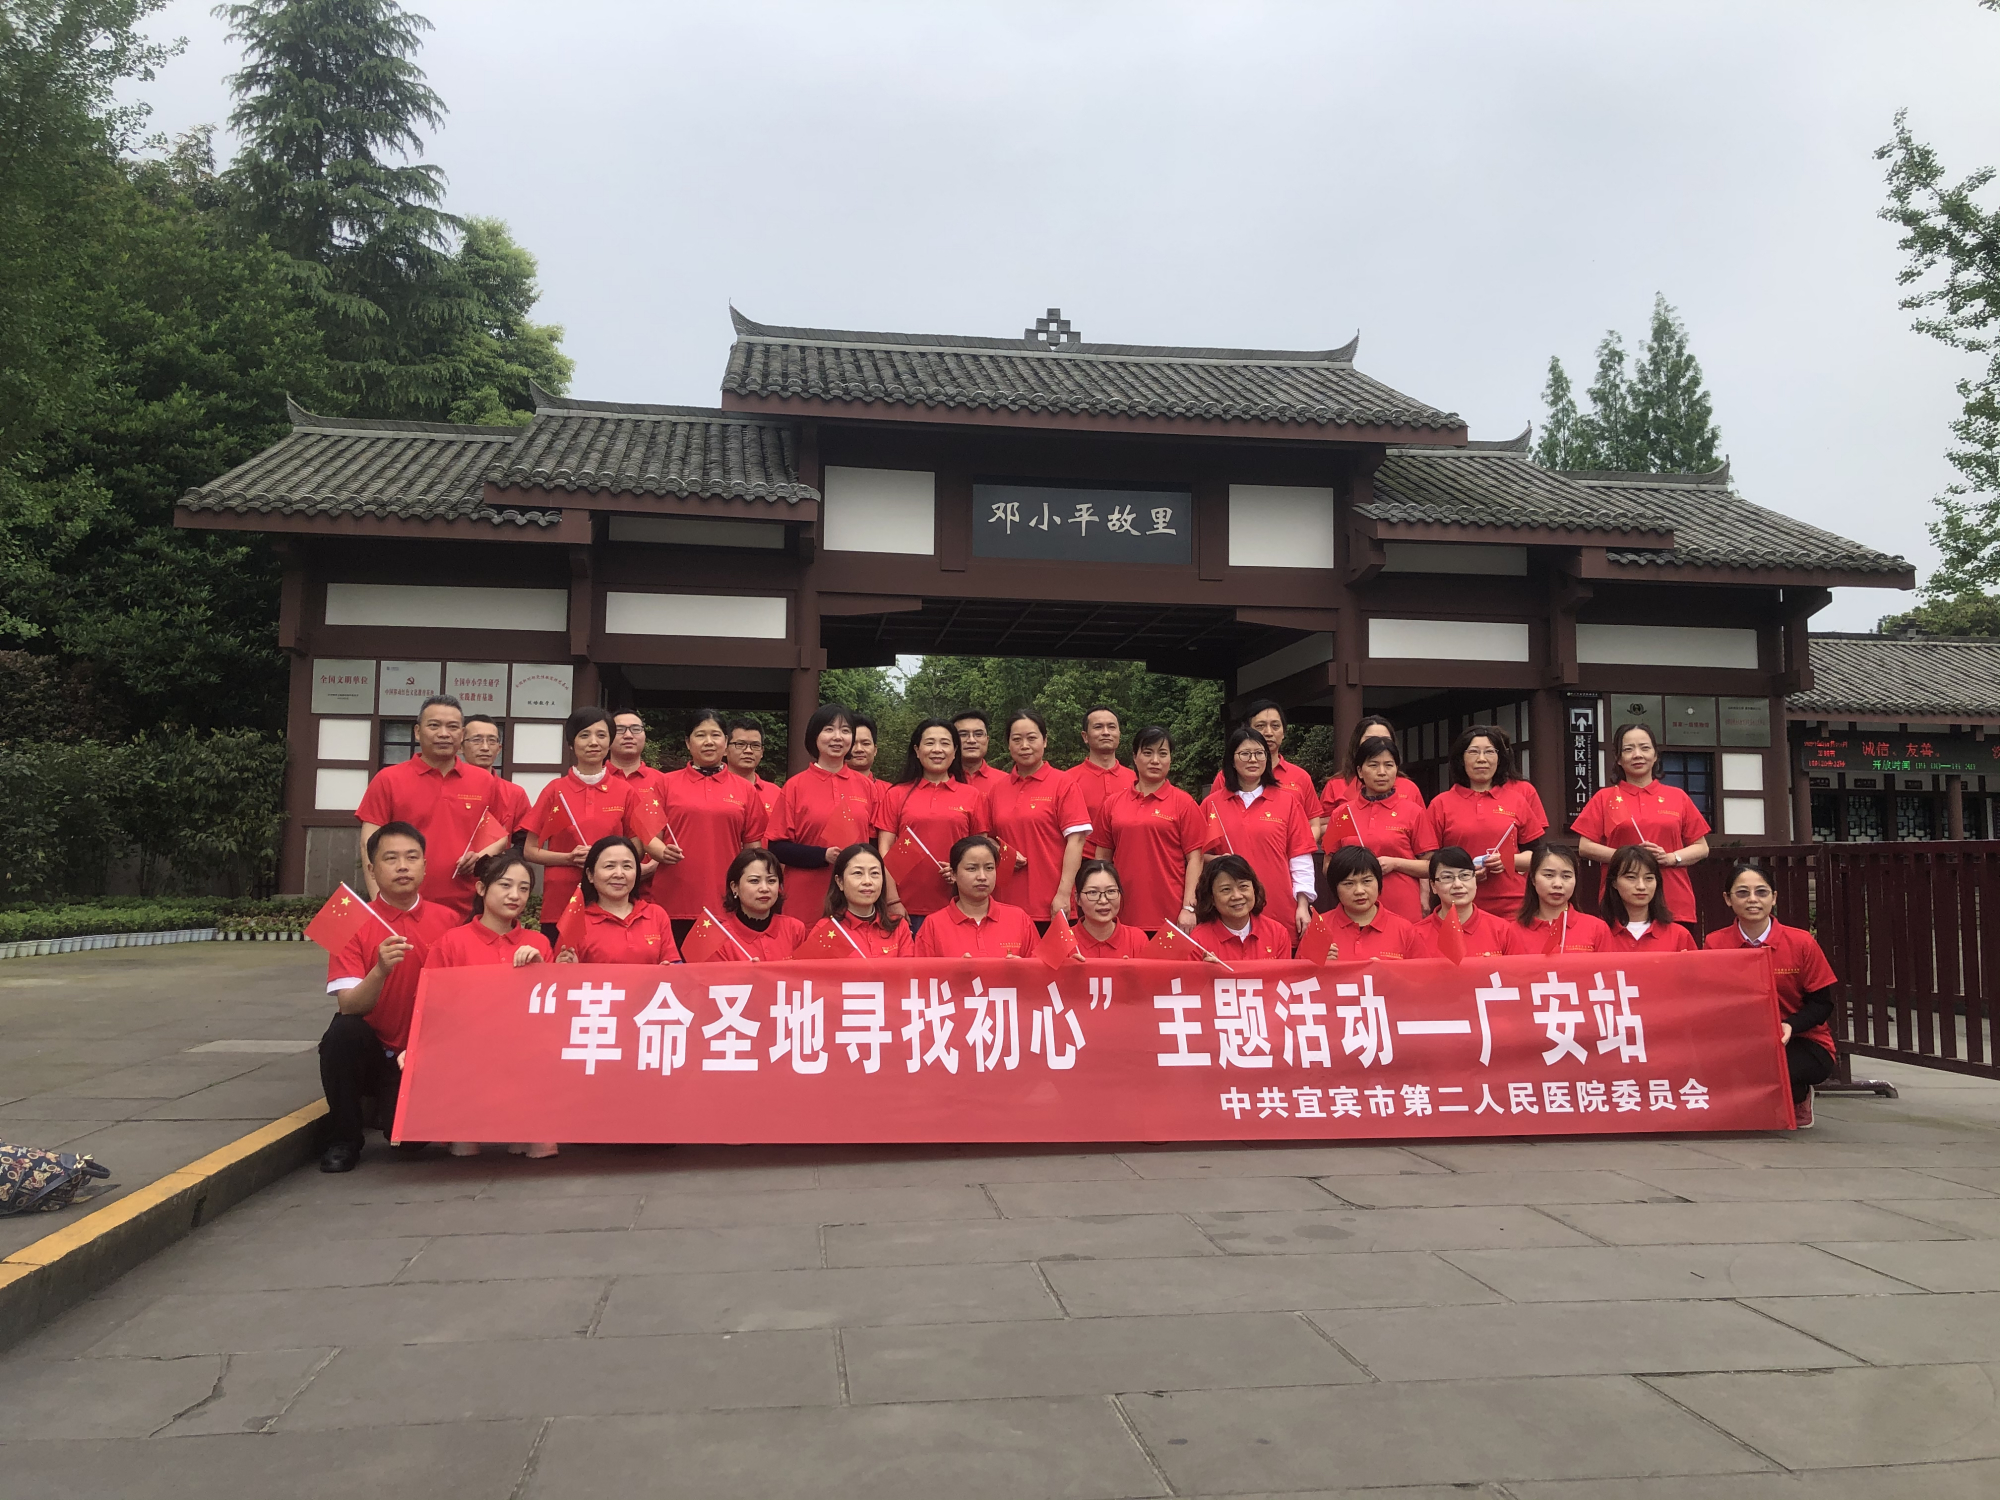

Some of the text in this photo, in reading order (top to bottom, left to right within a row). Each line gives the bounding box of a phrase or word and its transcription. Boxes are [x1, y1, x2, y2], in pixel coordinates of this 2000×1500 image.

[987, 501, 1177, 537] 邓小平故里
[320, 674, 369, 685] 全国文明单位
[453, 677, 500, 688] 全国中小学生研学
[458, 692, 494, 702] 实践教育基地
[1574, 734, 1587, 804] 景区南入口
[1872, 760, 1911, 771] 开放时间
[1219, 1077, 1711, 1120] 中共宜宾市第二人民医院委员会
